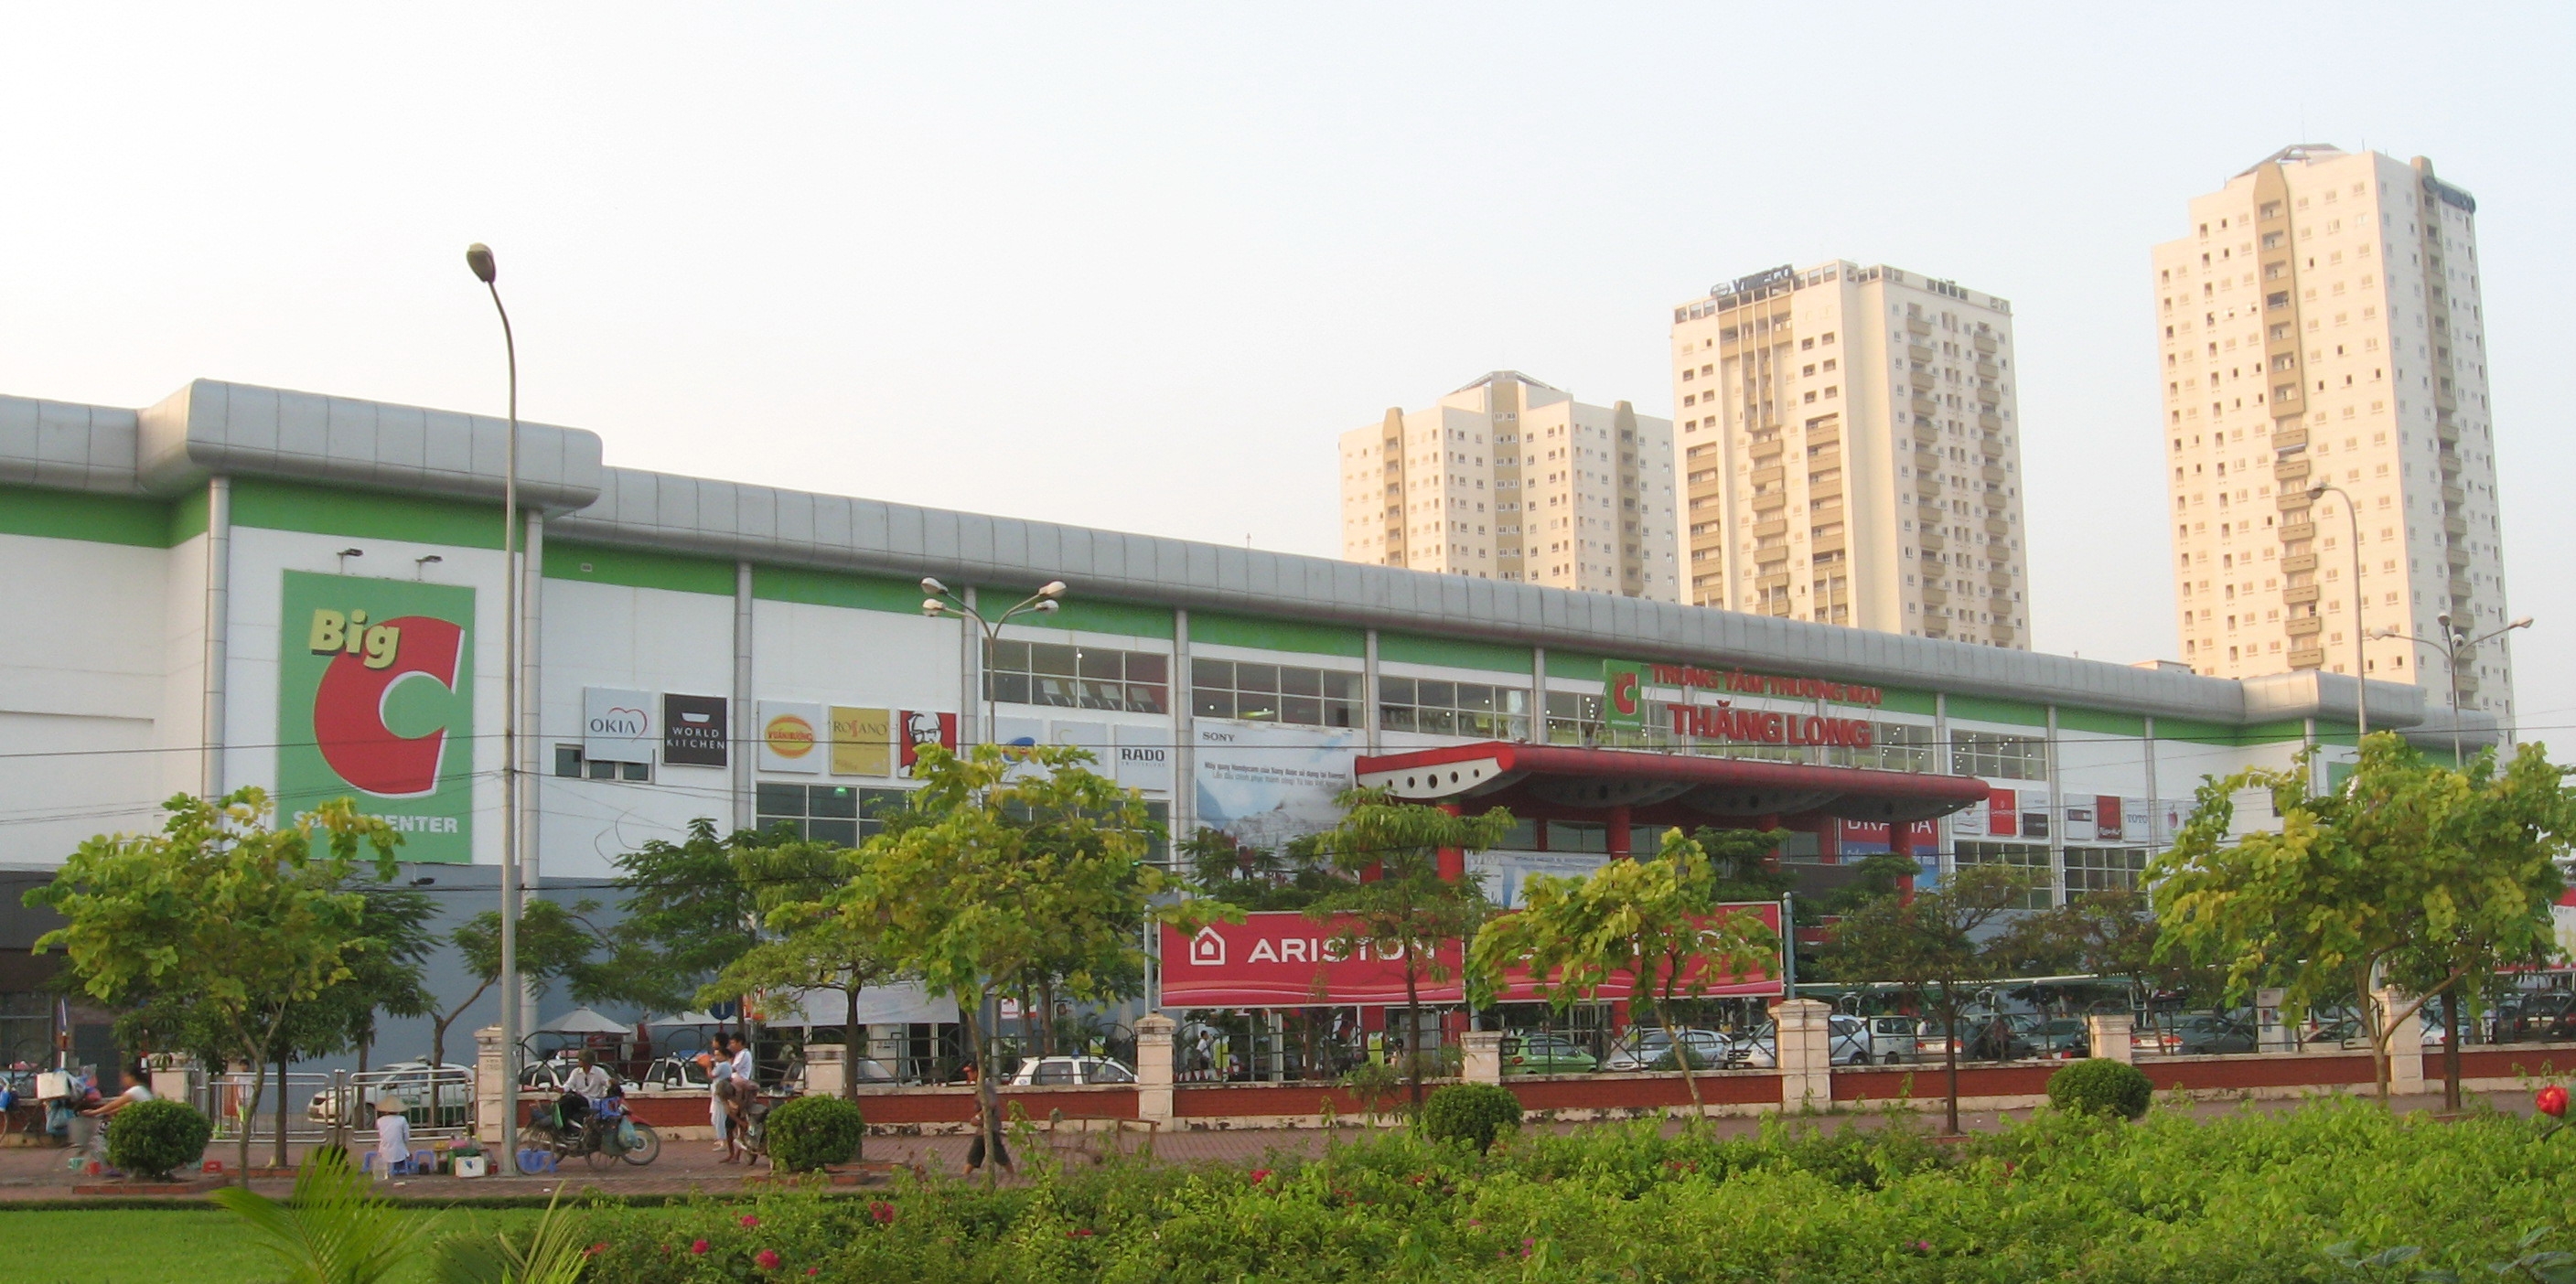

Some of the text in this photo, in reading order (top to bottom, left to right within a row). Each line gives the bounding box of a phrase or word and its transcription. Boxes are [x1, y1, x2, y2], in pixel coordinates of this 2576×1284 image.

[309, 609, 401, 669] Big
[314, 615, 465, 798] C
[590, 718, 636, 733] OKIA
[1667, 700, 1871, 749] THĂNG LONG
[672, 726, 719, 738] WORLD
[1202, 732, 1236, 743] SONY
[666, 739, 725, 749] KITCHEN
[1121, 748, 1165, 762] RADO
